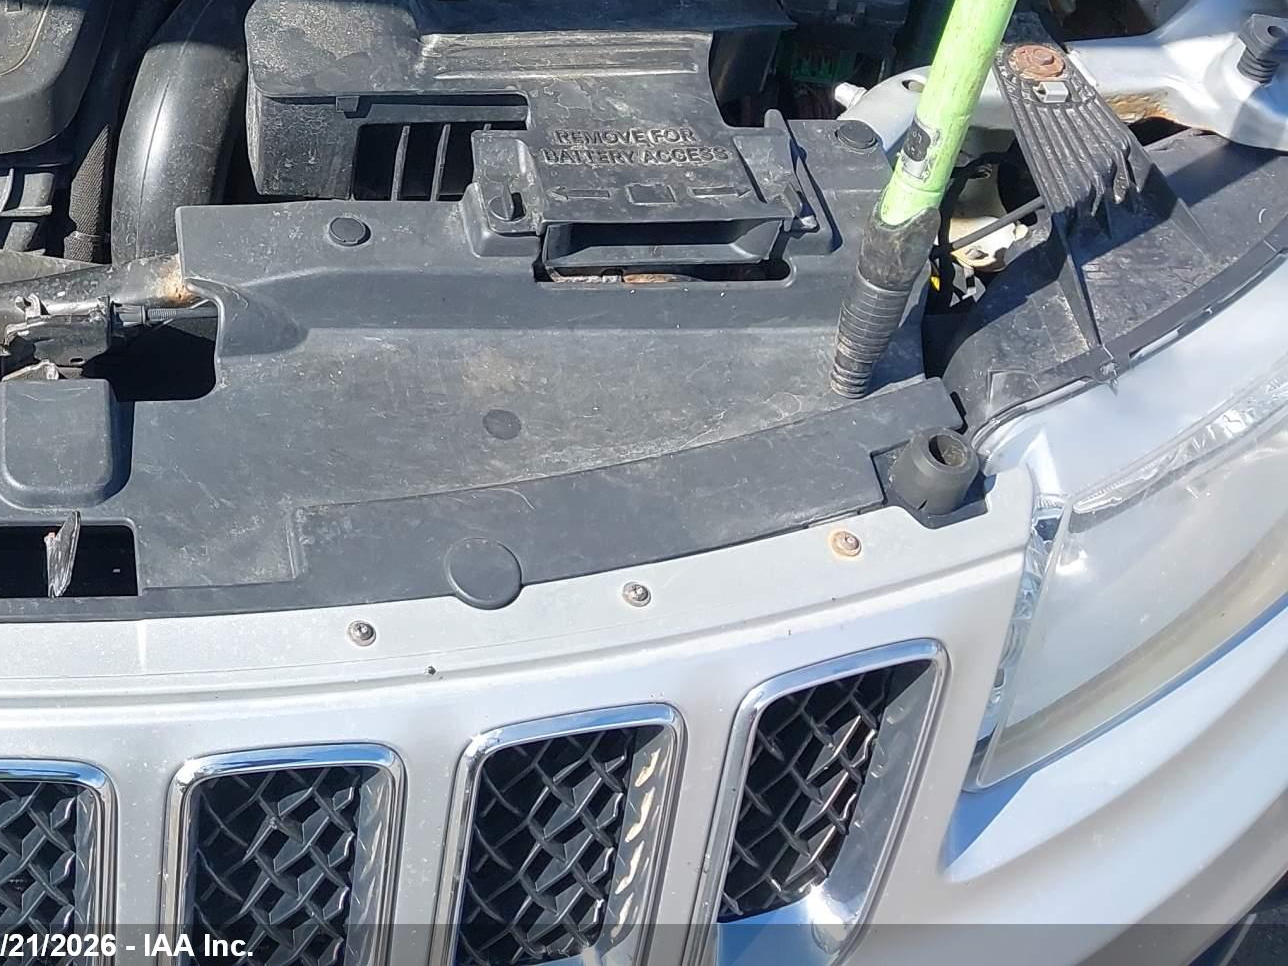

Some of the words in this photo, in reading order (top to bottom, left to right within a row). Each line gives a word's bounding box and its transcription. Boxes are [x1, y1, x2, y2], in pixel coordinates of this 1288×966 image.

[554, 128, 648, 146] REMOVE
[650, 128, 697, 145] FOR
[542, 147, 635, 165] BATTERY
[641, 146, 729, 164] ACCESS
